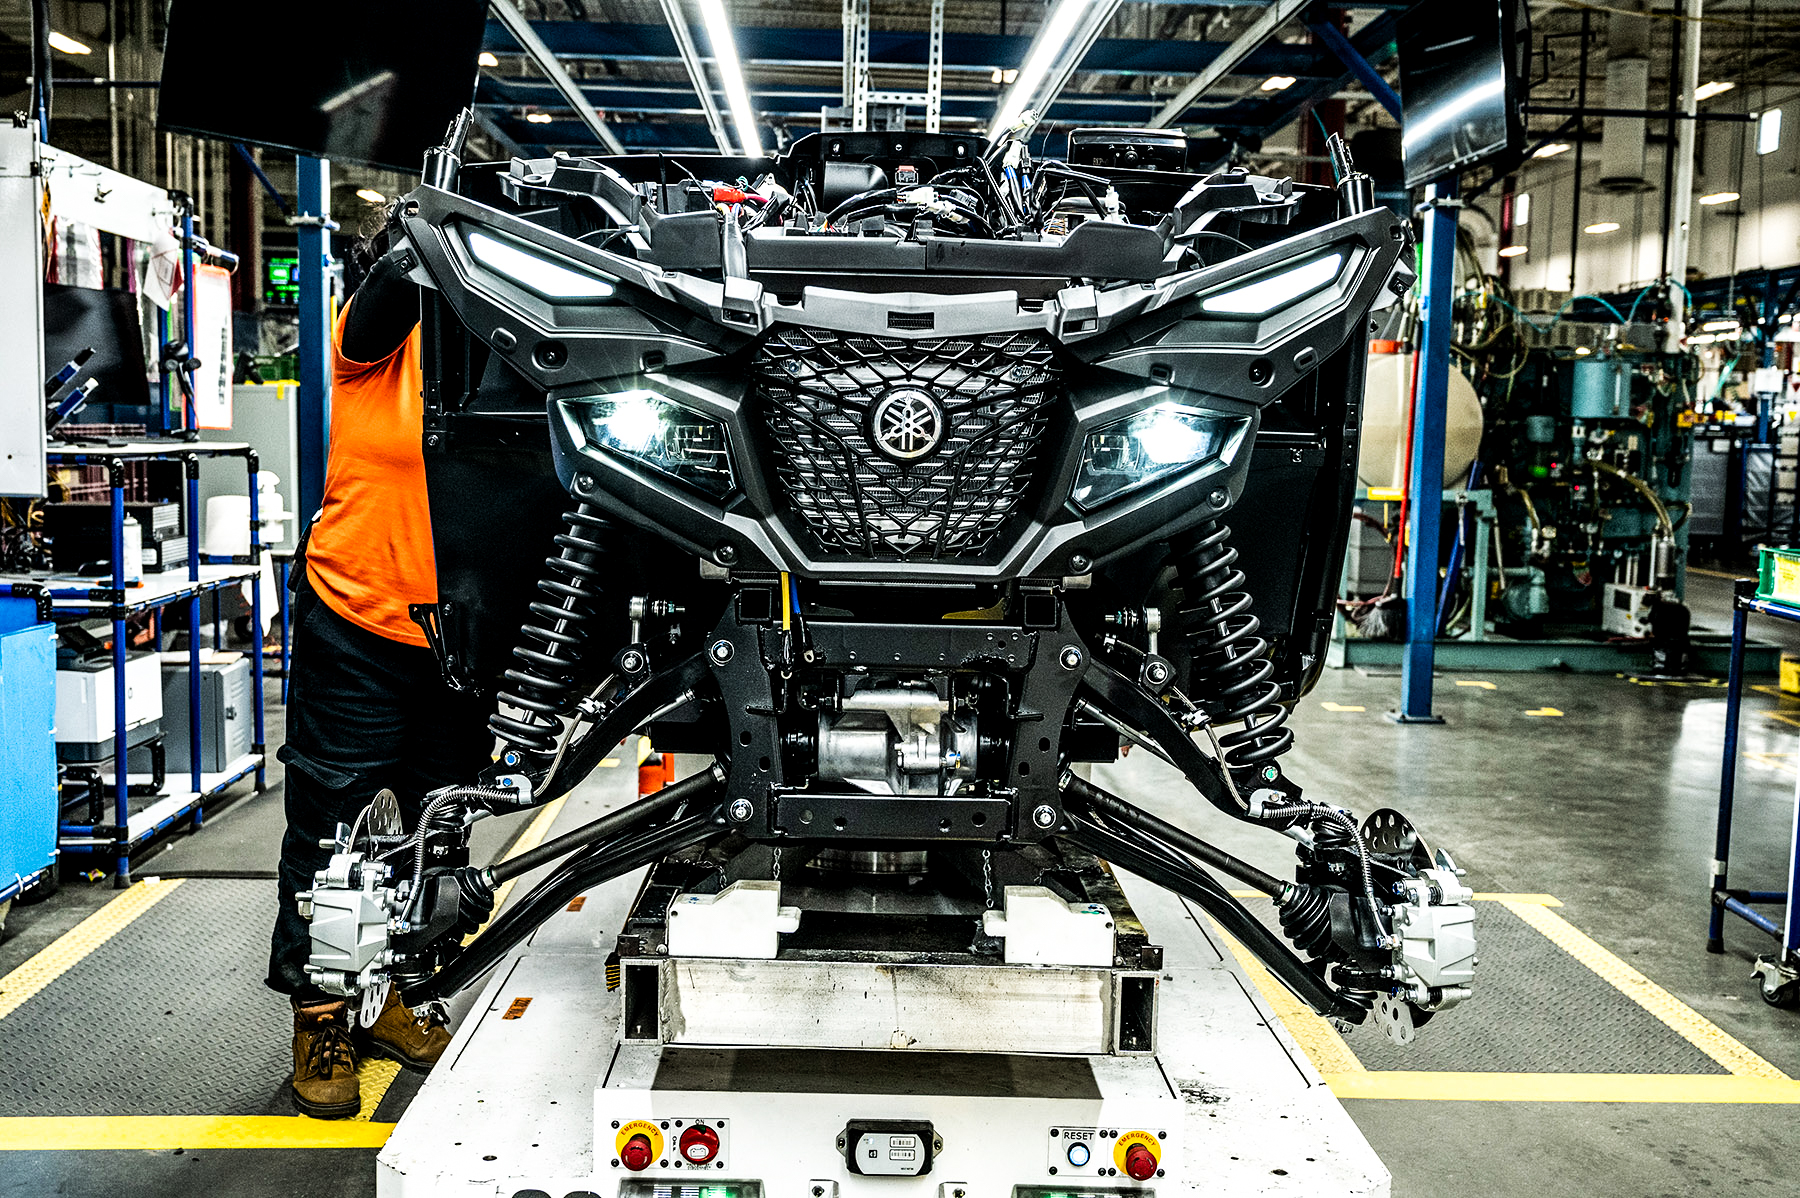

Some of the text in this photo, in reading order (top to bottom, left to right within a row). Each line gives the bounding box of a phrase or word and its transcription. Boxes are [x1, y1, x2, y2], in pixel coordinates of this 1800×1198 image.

[621, 1122, 659, 1136] EMERGENCY
[1064, 1132, 1094, 1140] RESET
[1118, 1133, 1156, 1146] EMERGENCY
